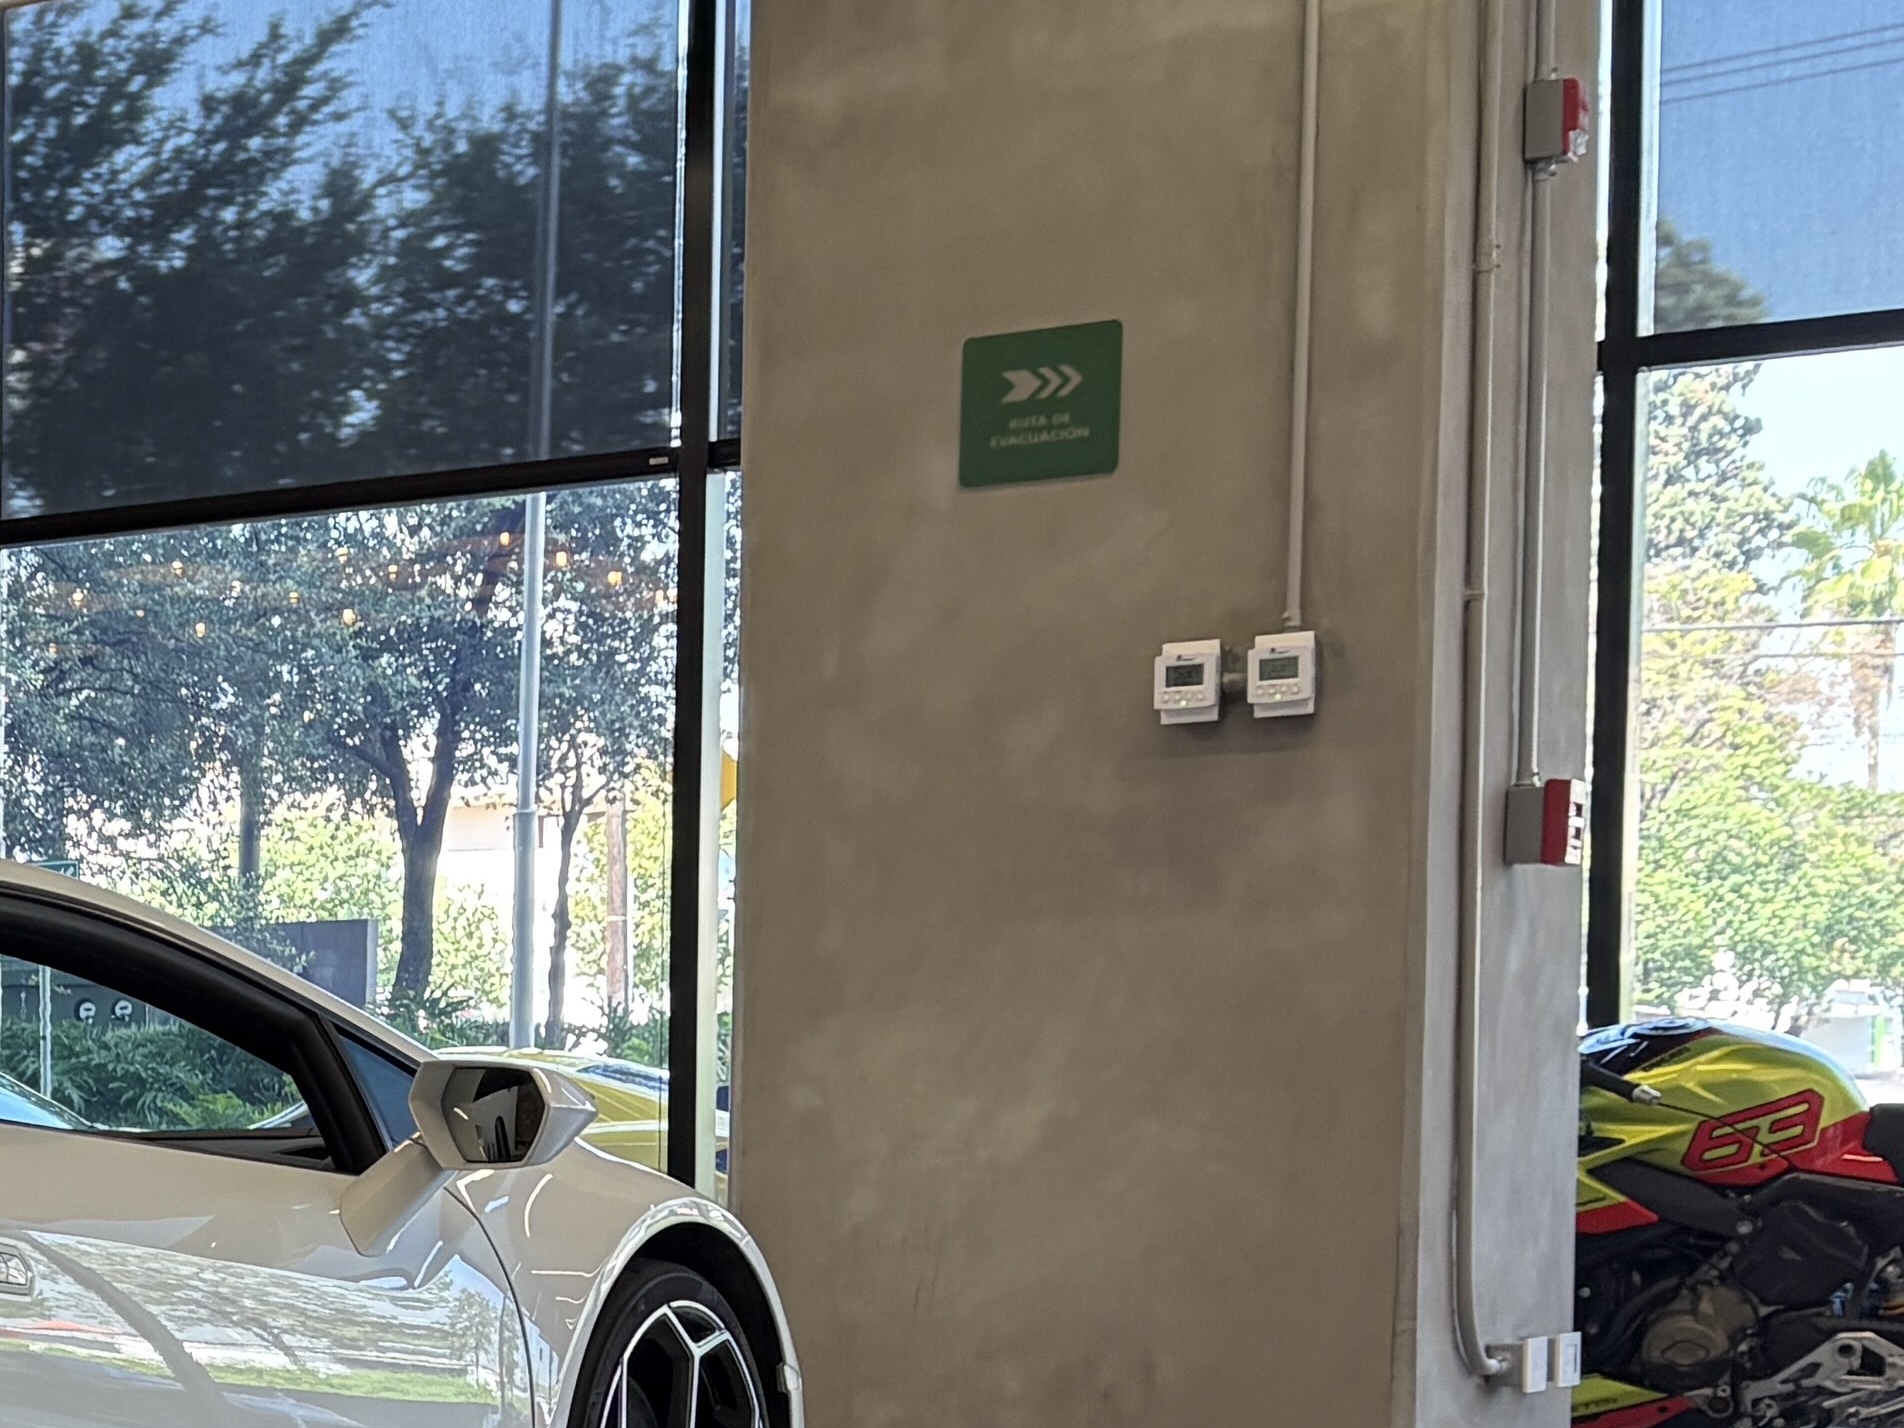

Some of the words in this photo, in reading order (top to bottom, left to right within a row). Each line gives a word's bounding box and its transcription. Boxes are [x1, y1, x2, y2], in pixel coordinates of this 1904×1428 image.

[1009, 415, 1047, 430] RUTA
[1052, 412, 1071, 425] DE
[1680, 1087, 1825, 1173] 63
